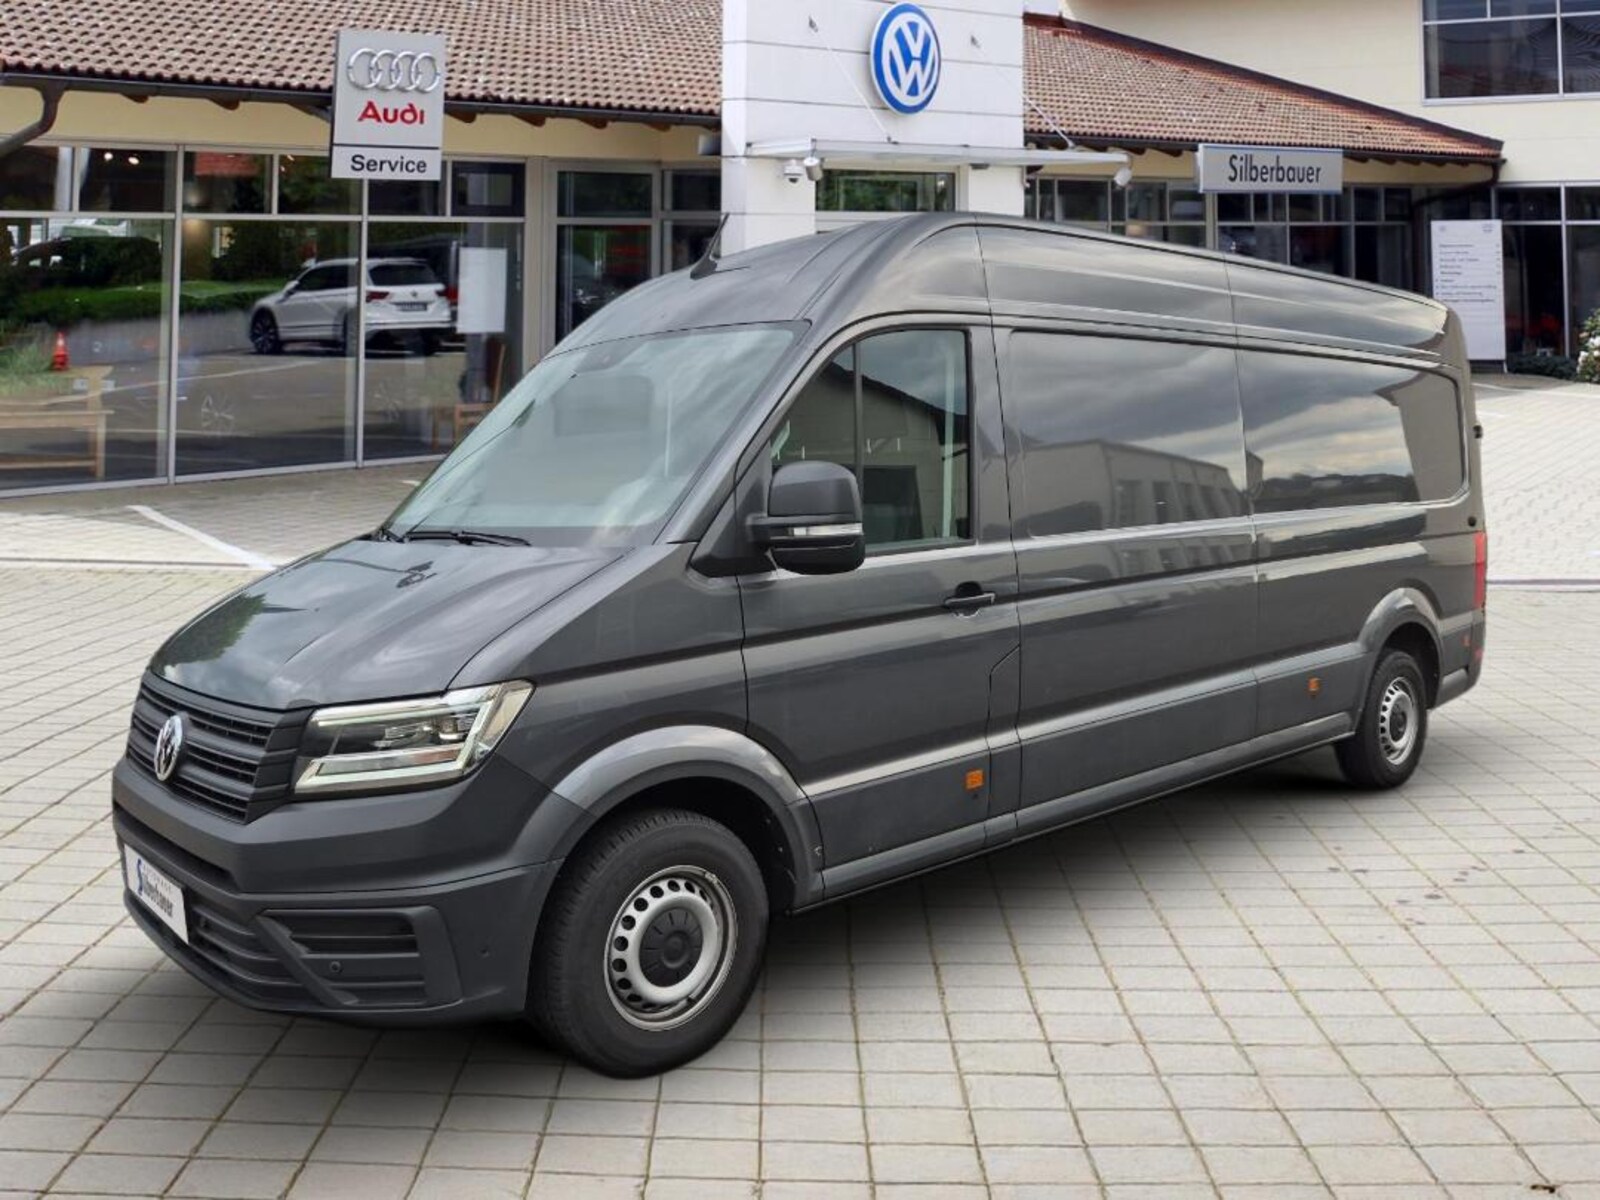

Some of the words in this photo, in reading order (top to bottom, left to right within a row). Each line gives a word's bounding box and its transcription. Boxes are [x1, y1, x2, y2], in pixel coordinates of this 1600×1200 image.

[358, 101, 425, 125] Audi
[351, 154, 427, 173] Service
[1228, 153, 1322, 183] Silberbauer
